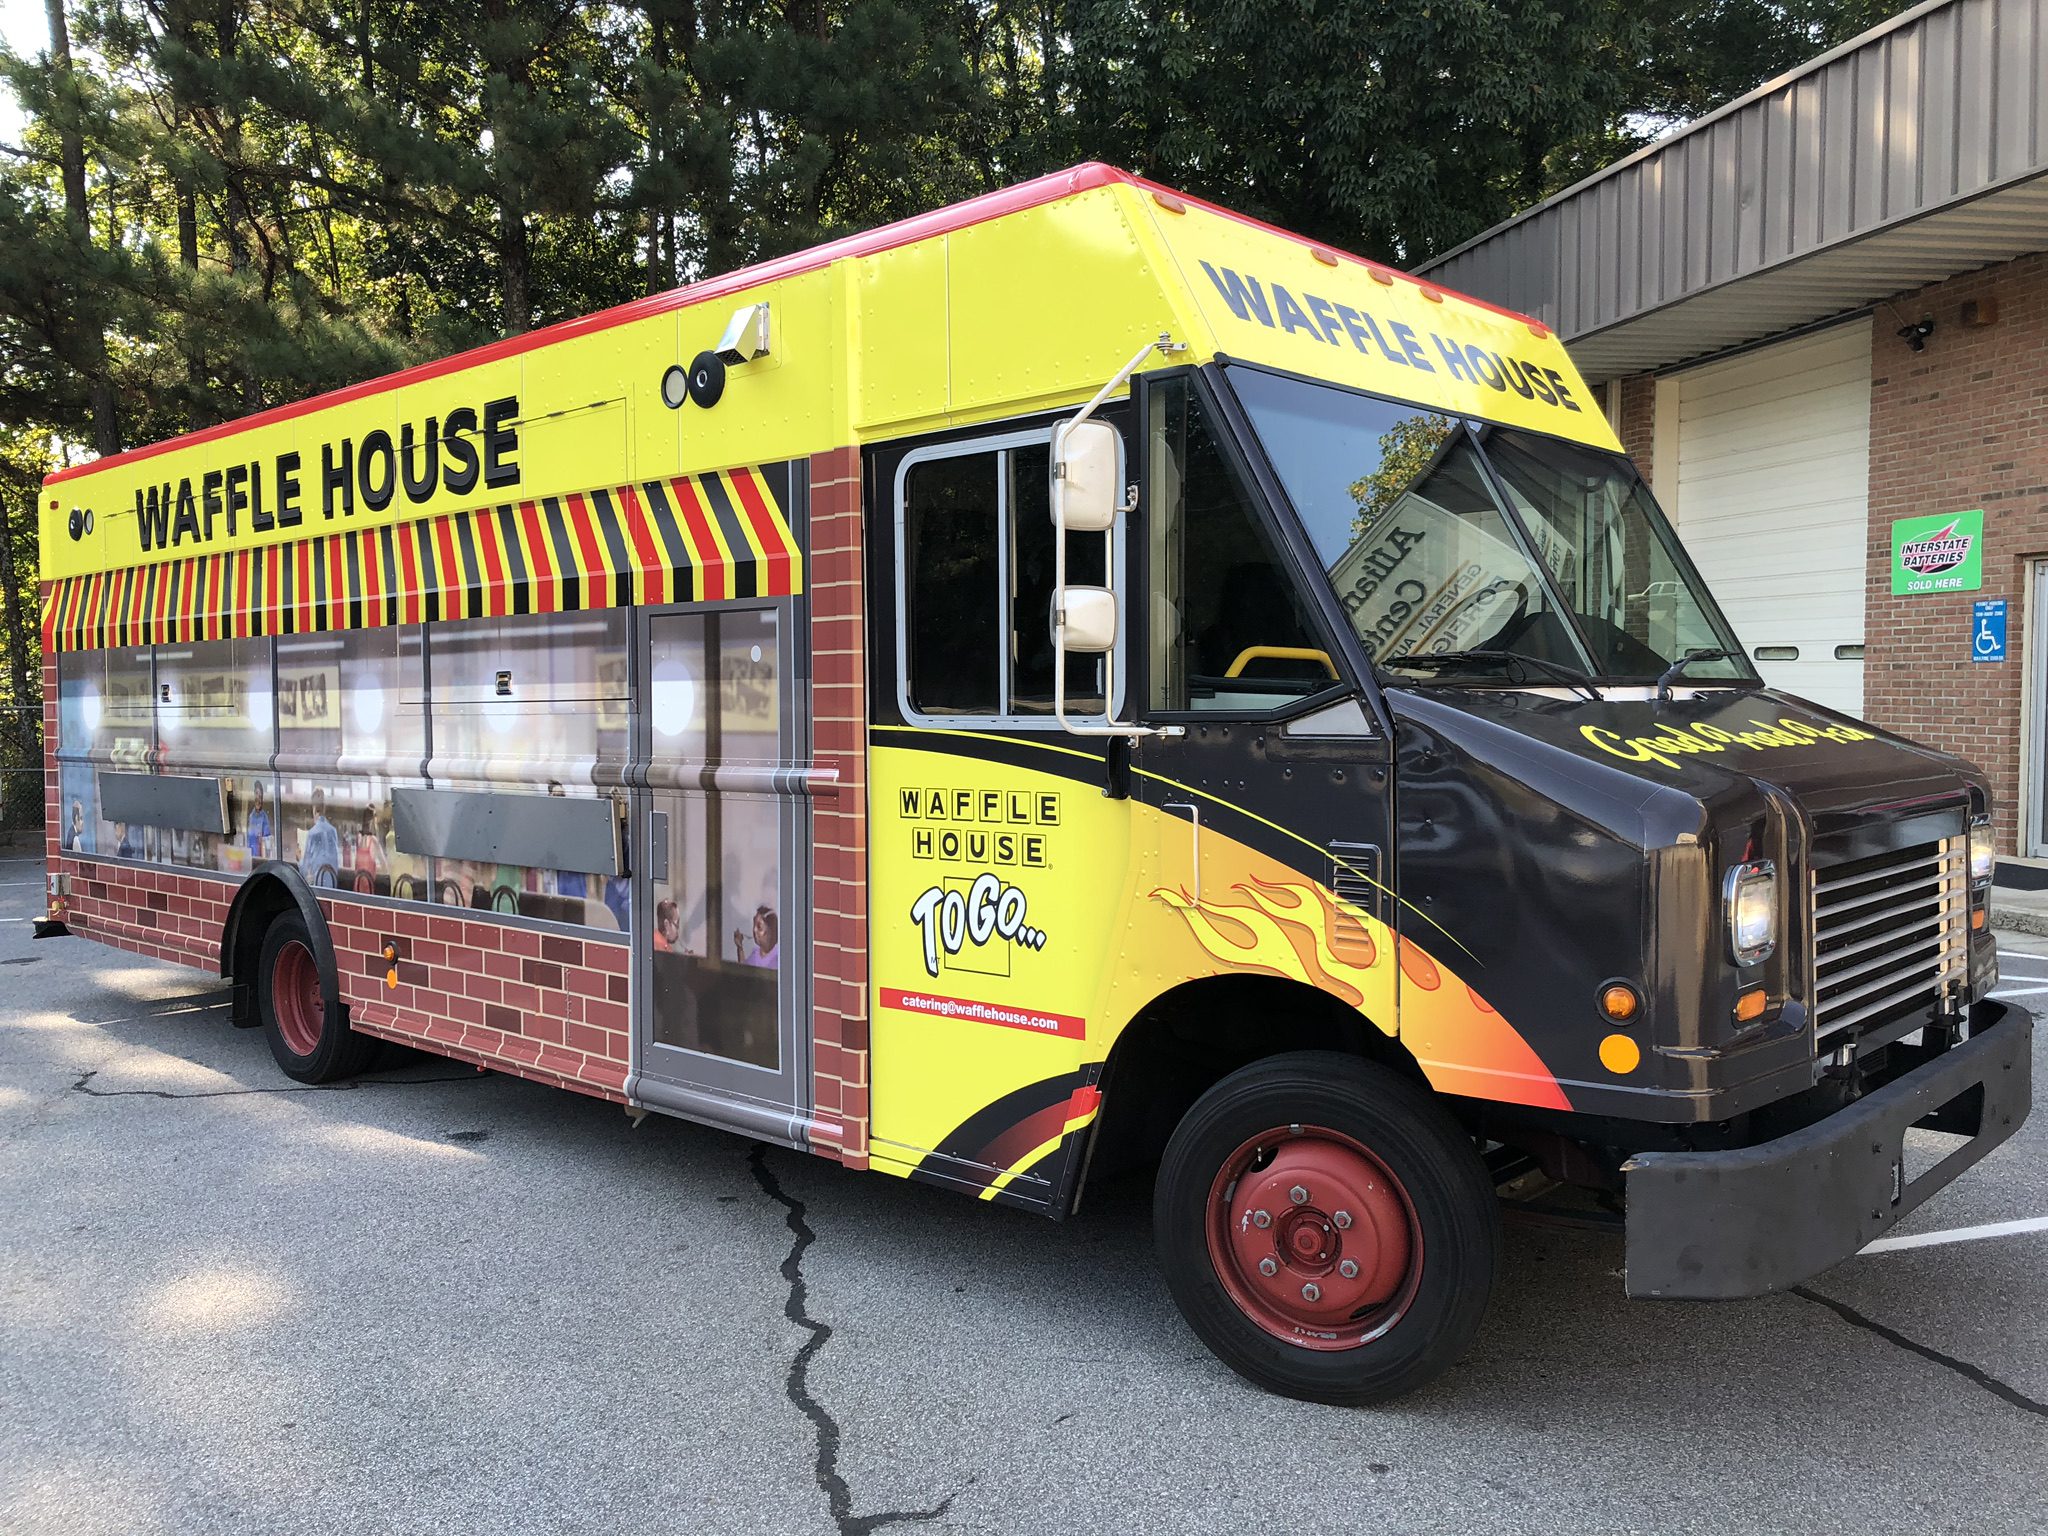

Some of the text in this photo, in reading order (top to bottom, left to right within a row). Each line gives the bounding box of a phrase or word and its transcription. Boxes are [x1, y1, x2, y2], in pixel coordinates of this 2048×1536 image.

[1198, 259, 1583, 413] WAFFLE HOUSE
[135, 395, 520, 552] WAFFLE HOUSE
[1901, 538, 1969, 554] INTERSTATE
[1903, 551, 1964, 567] BATTERIES
[1907, 578, 1963, 591] SOLD HERE
[1579, 722, 1725, 770] Good
[900, 789, 1058, 823] WAFFLE
[915, 830, 1043, 863] HOUSE
[902, 995, 1058, 1031] catering@wafflehouse.com
